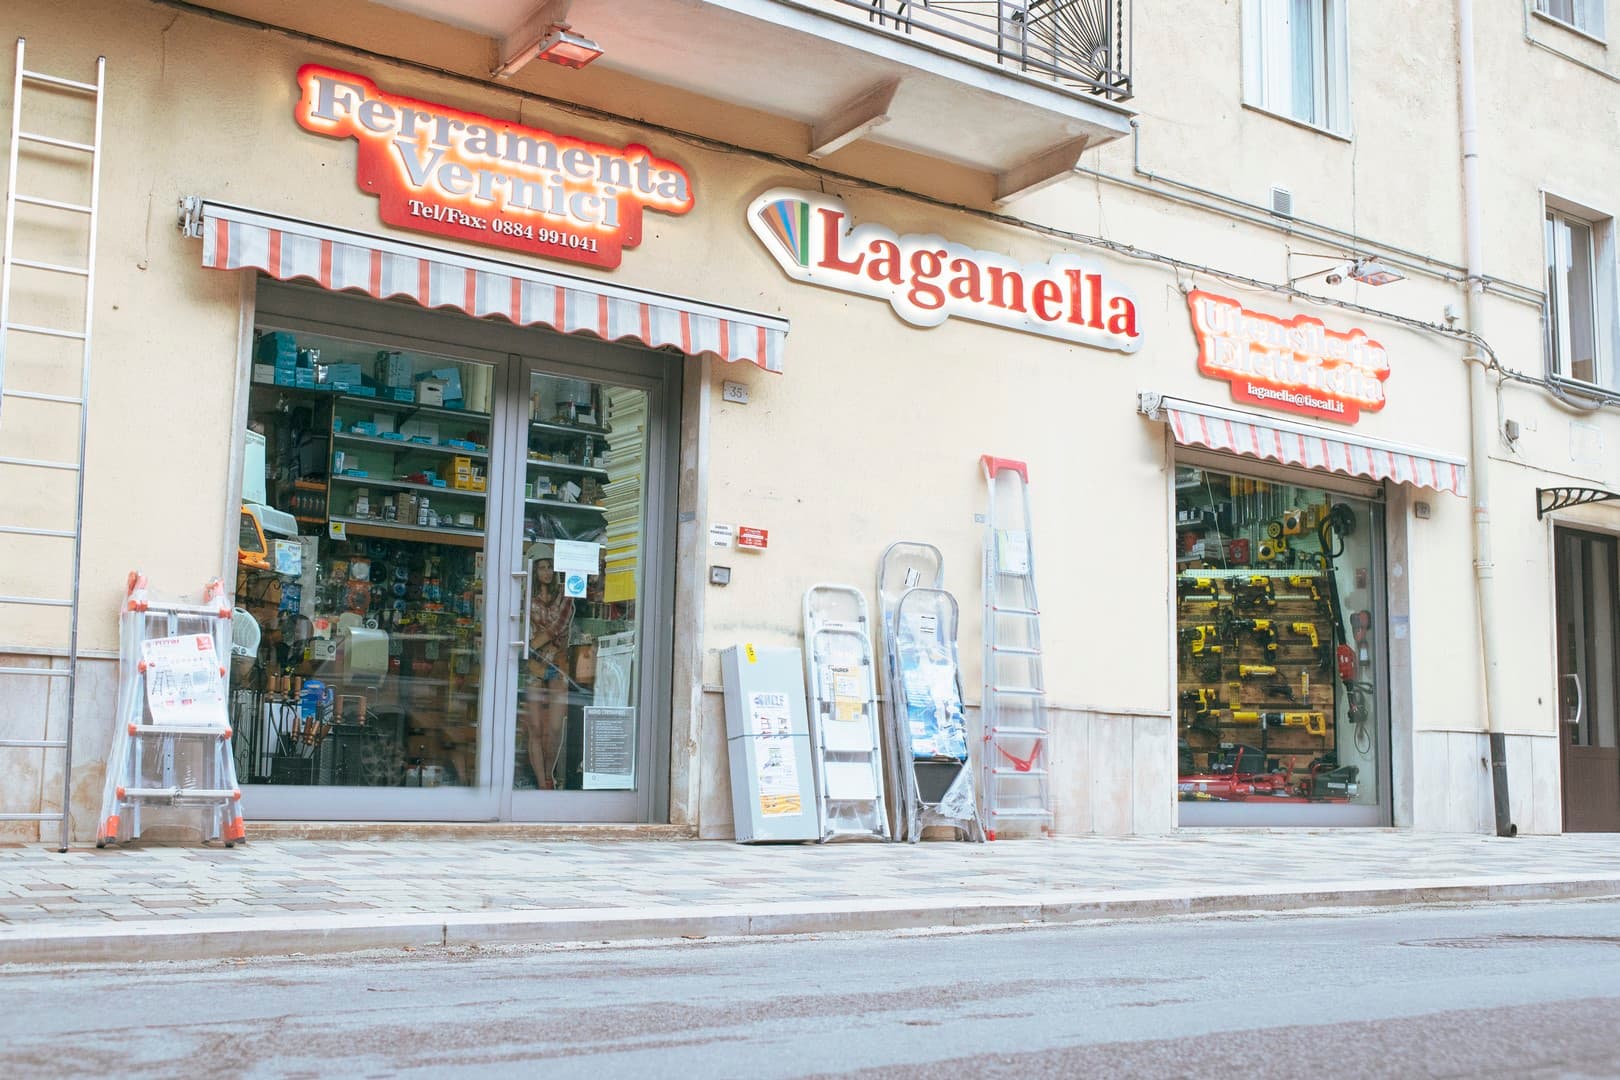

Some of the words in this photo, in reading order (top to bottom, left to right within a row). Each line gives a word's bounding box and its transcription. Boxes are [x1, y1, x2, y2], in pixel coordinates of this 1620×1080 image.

[311, 76, 690, 202] Ferramenta
[393, 139, 620, 228] Vernici
[409, 200, 487, 230] Tel/Fax:
[491, 218, 534, 240] 0884
[538, 226, 599, 252] 991041
[817, 207, 1140, 337] Laganella
[730, 385, 742, 398] 35
